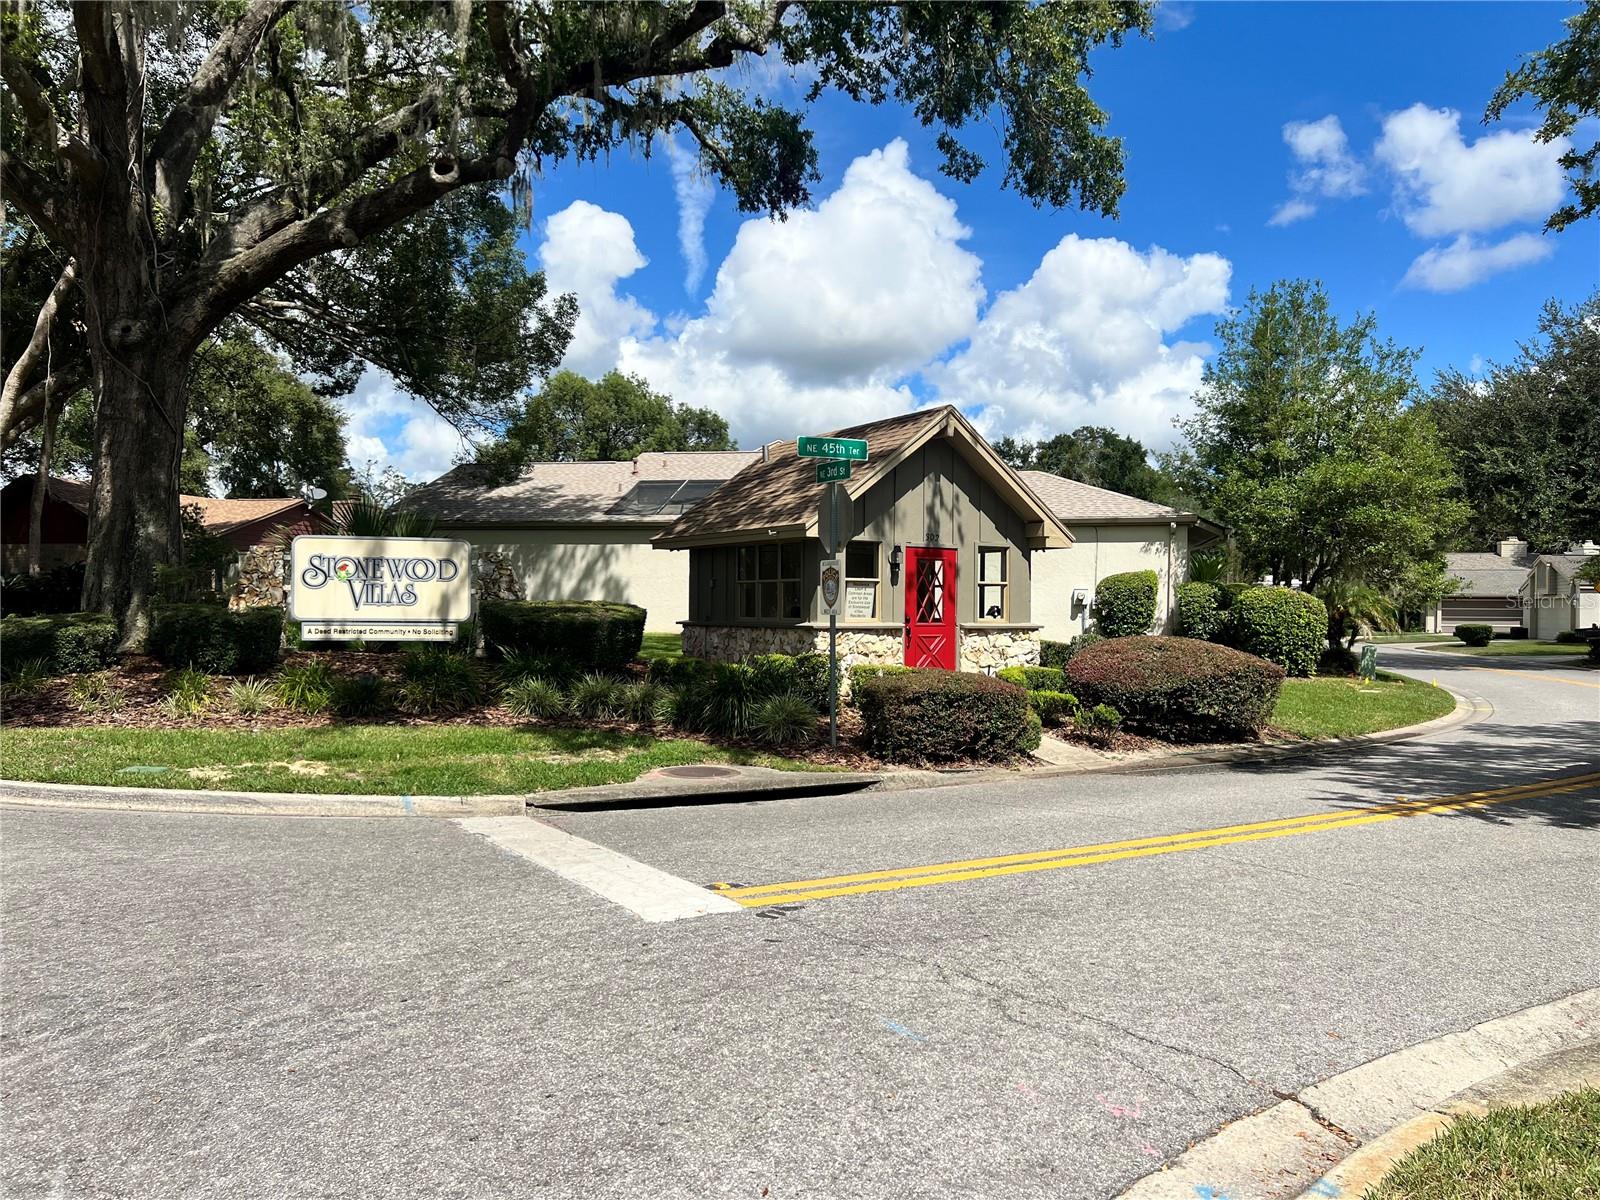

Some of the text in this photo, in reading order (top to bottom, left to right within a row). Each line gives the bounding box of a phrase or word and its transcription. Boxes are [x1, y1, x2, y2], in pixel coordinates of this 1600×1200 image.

[807, 443, 859, 455] NE 45th Ter
[826, 466, 838, 478] 3rd
[839, 467, 846, 476] St
[302, 553, 460, 590] STONEWOOD
[346, 579, 419, 611] VILLAS
[368, 628, 406, 636] Community
[423, 628, 453, 636] Soliciting
